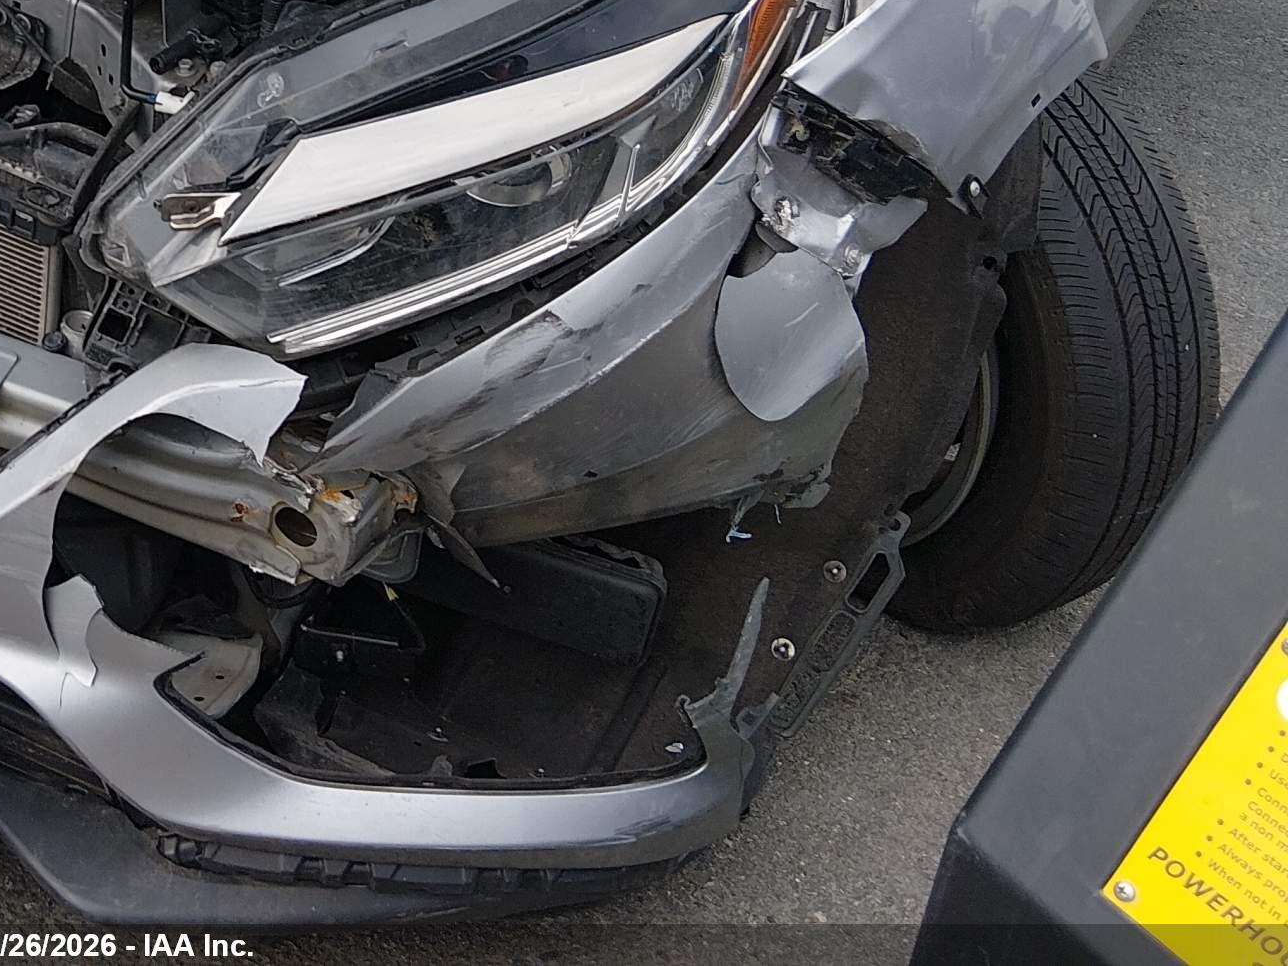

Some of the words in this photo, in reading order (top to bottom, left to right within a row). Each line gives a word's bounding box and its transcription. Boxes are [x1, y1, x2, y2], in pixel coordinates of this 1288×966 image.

[1228, 828, 1261, 853] After
[1250, 821, 1273, 841] non
[1216, 844, 1263, 880] Always
[1208, 858, 1243, 890] When
[1244, 889, 1268, 910] not
